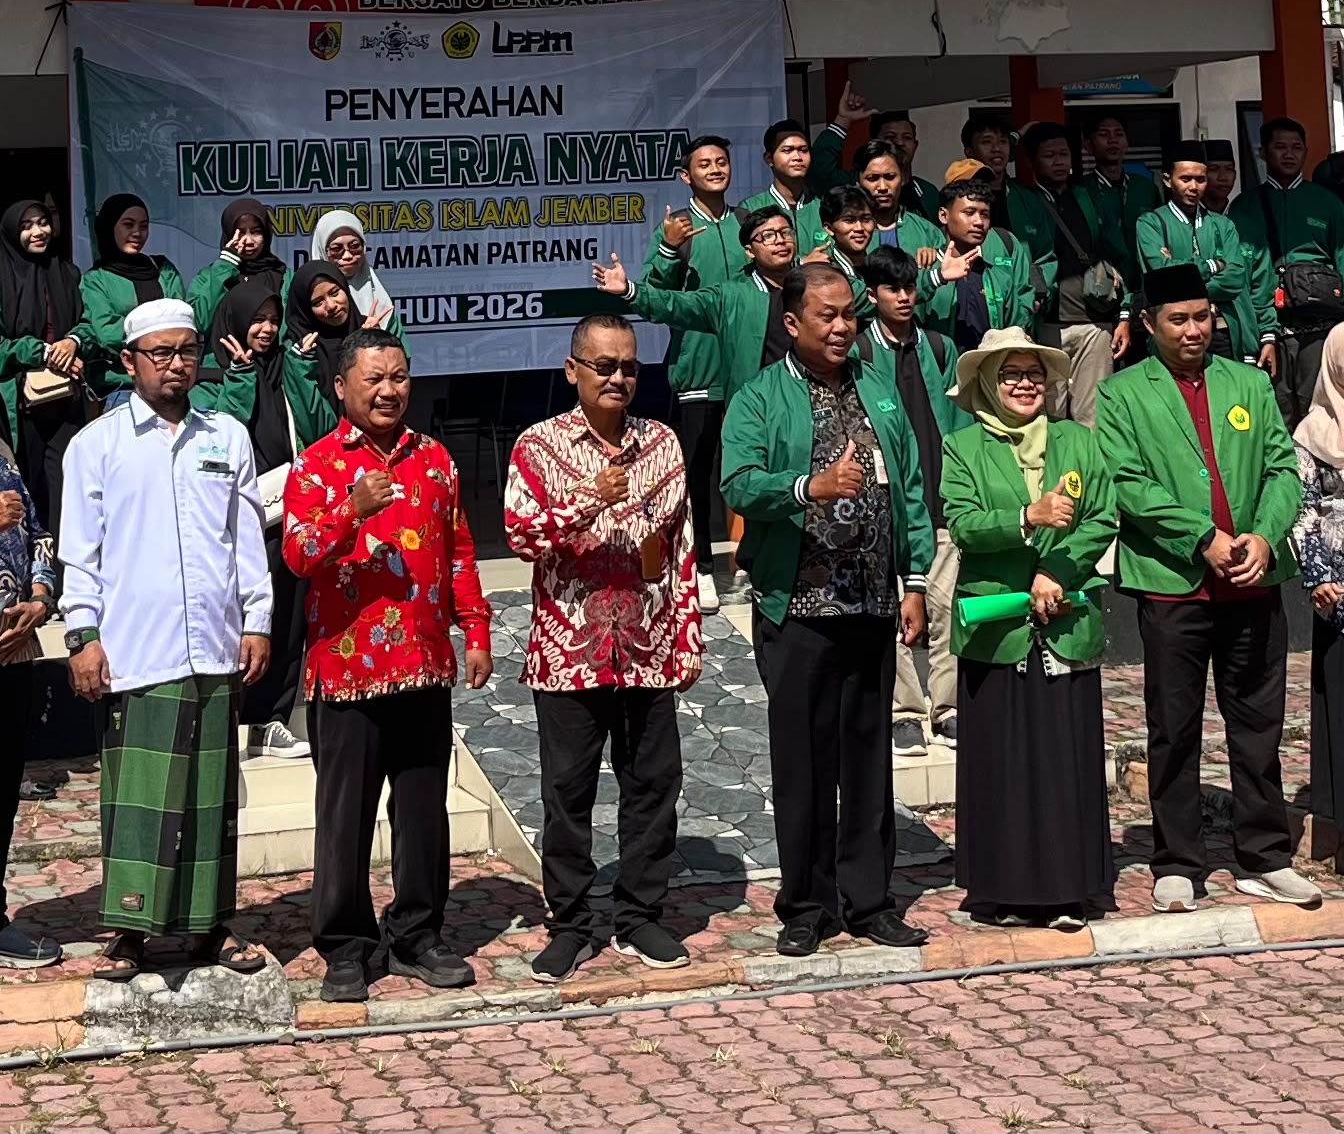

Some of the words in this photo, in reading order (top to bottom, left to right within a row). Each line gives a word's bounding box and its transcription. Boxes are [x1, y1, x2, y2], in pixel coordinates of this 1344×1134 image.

[324, 84, 565, 122] PENYERAHAN
[176, 137, 372, 197] KULIAH
[380, 134, 539, 191] KERJA
[544, 129, 693, 187] NYATA
[437, 196, 531, 232] ISLAM
[533, 191, 646, 227] JEMBER
[486, 237, 599, 265] PATRANG
[394, 296, 458, 324] HUN
[467, 292, 544, 321] 2026
